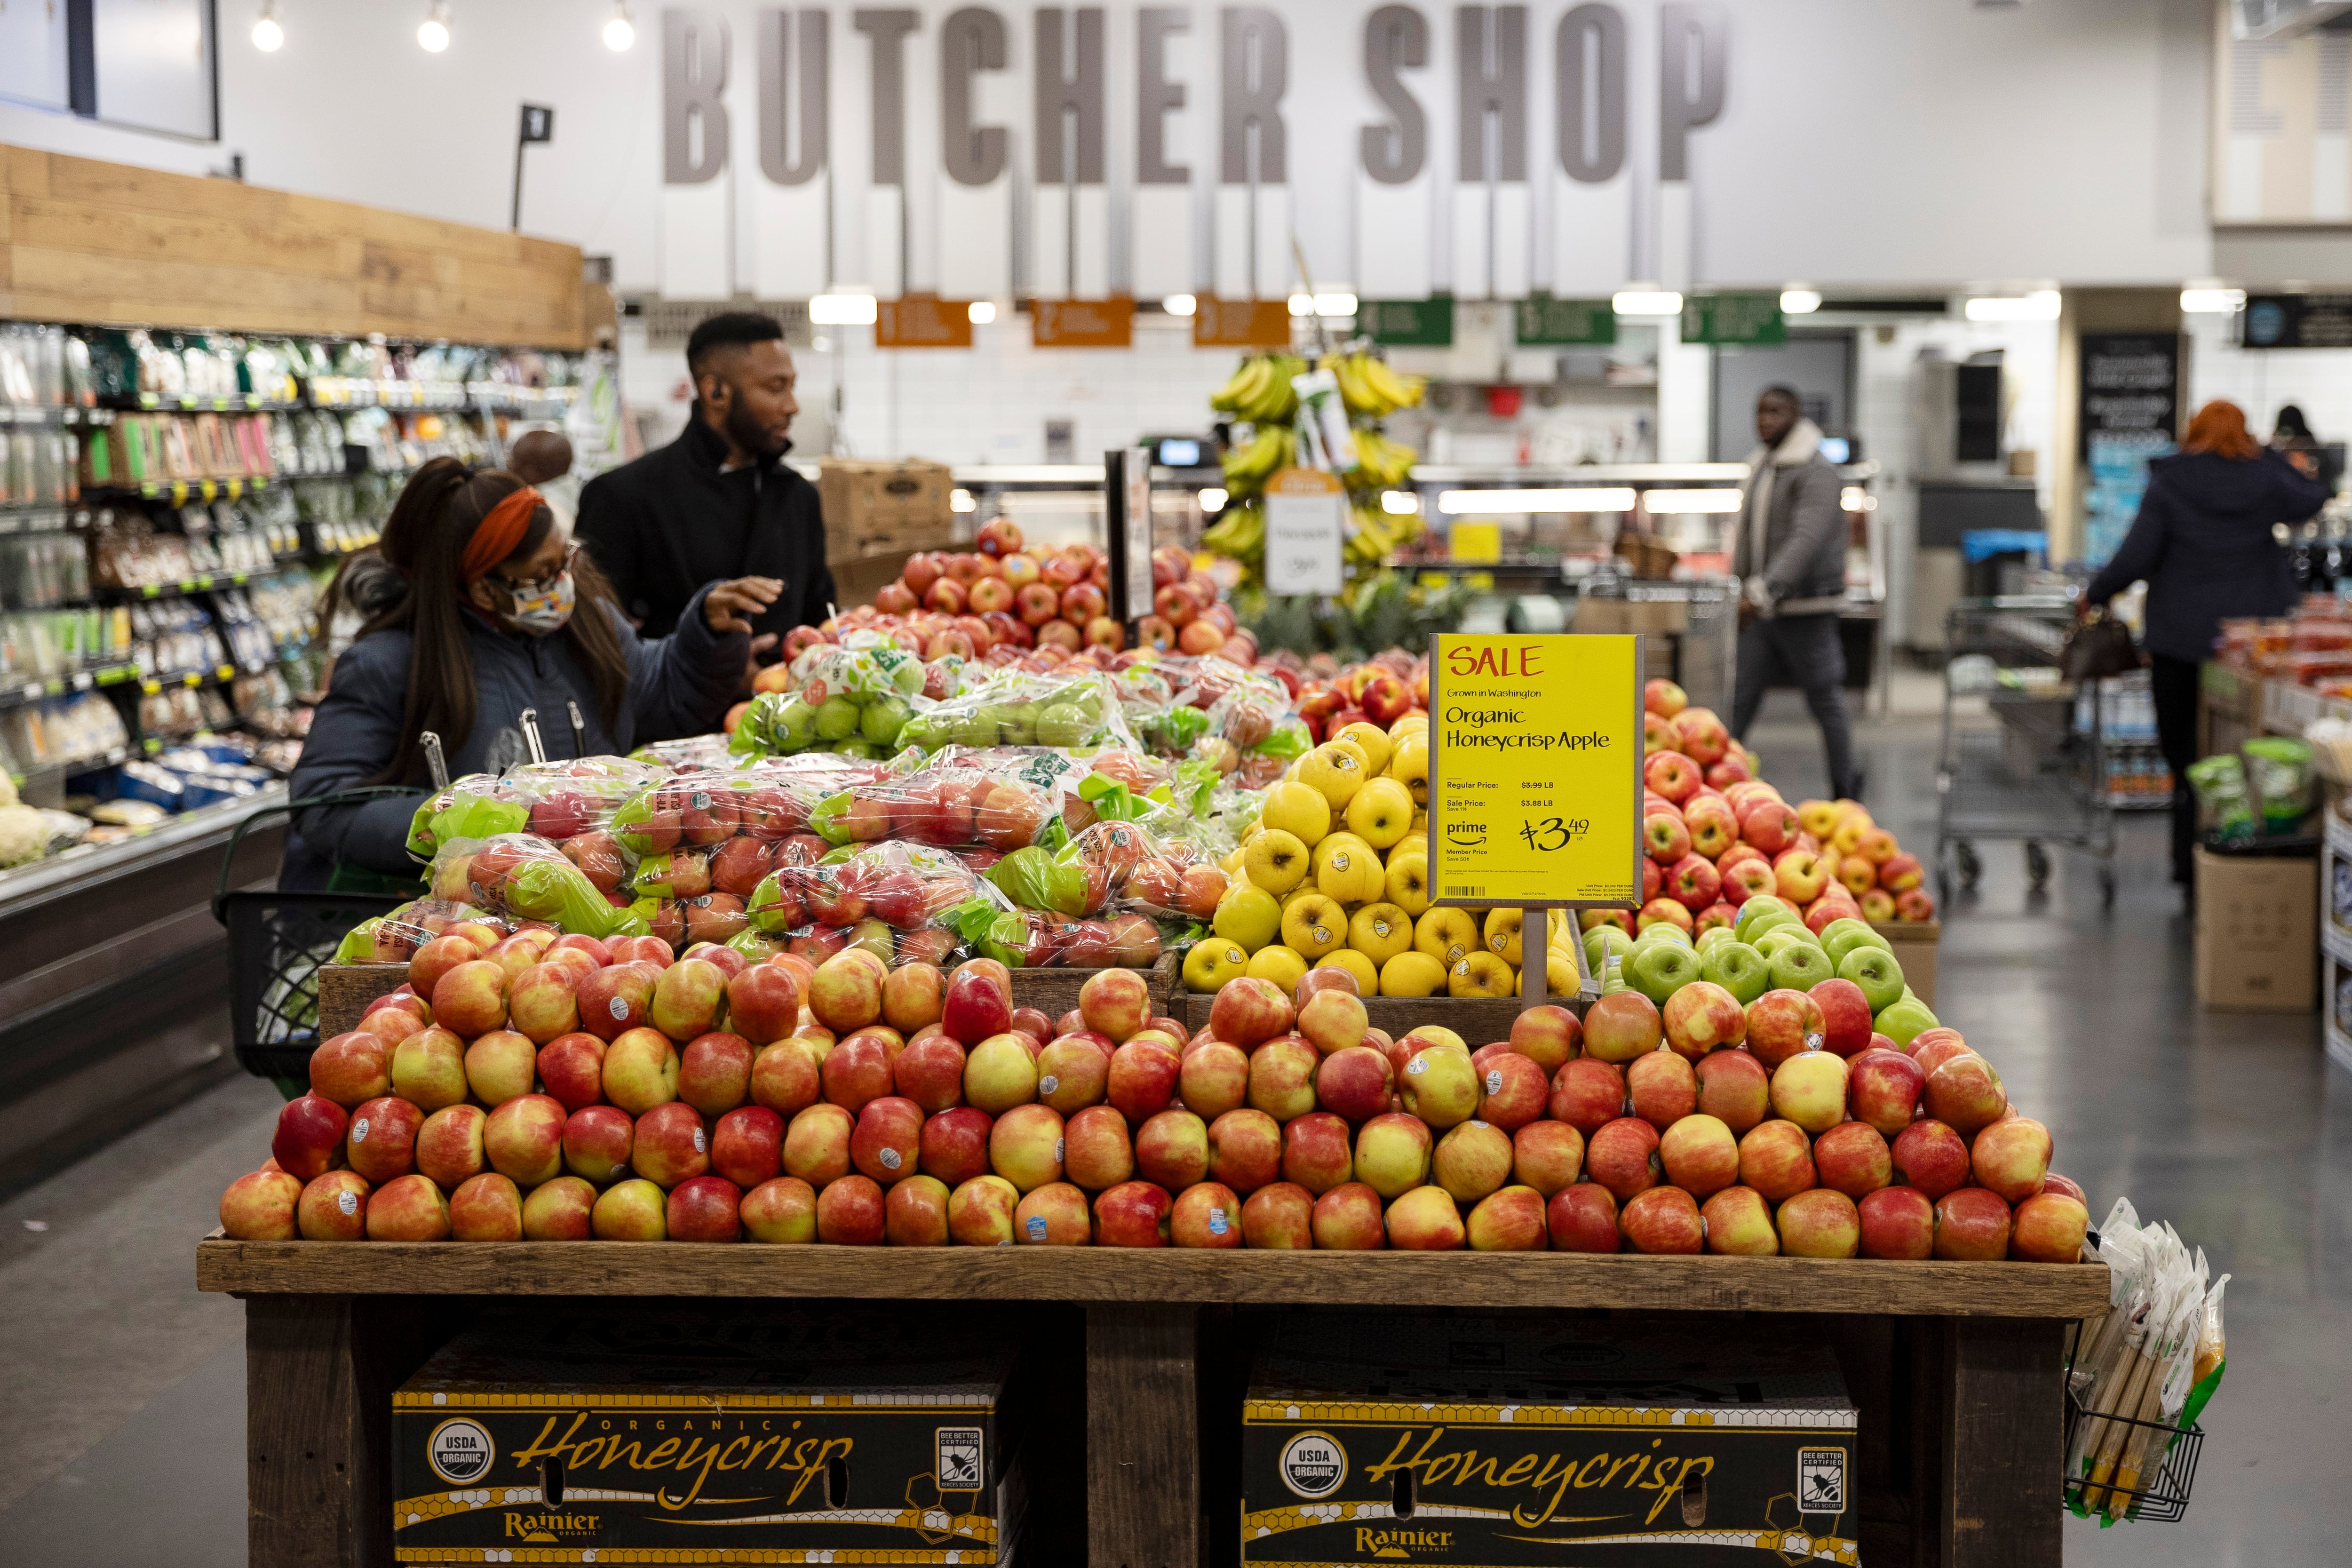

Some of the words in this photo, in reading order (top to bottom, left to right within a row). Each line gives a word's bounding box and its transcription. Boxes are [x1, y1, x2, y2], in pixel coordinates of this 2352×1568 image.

[664, 4, 1287, 185] BUTCHER
[1359, 4, 1728, 184] SHOP
[1447, 645, 1545, 677] SALE
[1488, 689, 1542, 700] Washington
[1446, 707, 1526, 728] Organic
[1447, 730, 1556, 752] Honeycrisp
[1558, 731, 1611, 751] Apple
[1447, 821, 1487, 836] prime
[393, 935, 403, 947] USA
[446, 1437, 477, 1449] USDA
[442, 1453, 481, 1463] ORGANIC
[511, 1412, 853, 1510] Honeycrisp
[1298, 1449, 1330, 1462] USDA
[1295, 1466, 1334, 1477] ORGANIC
[1365, 1427, 1714, 1528] Honeycrisp
[504, 1512, 599, 1537] Rainier
[1355, 1527, 1452, 1552] Rainier
